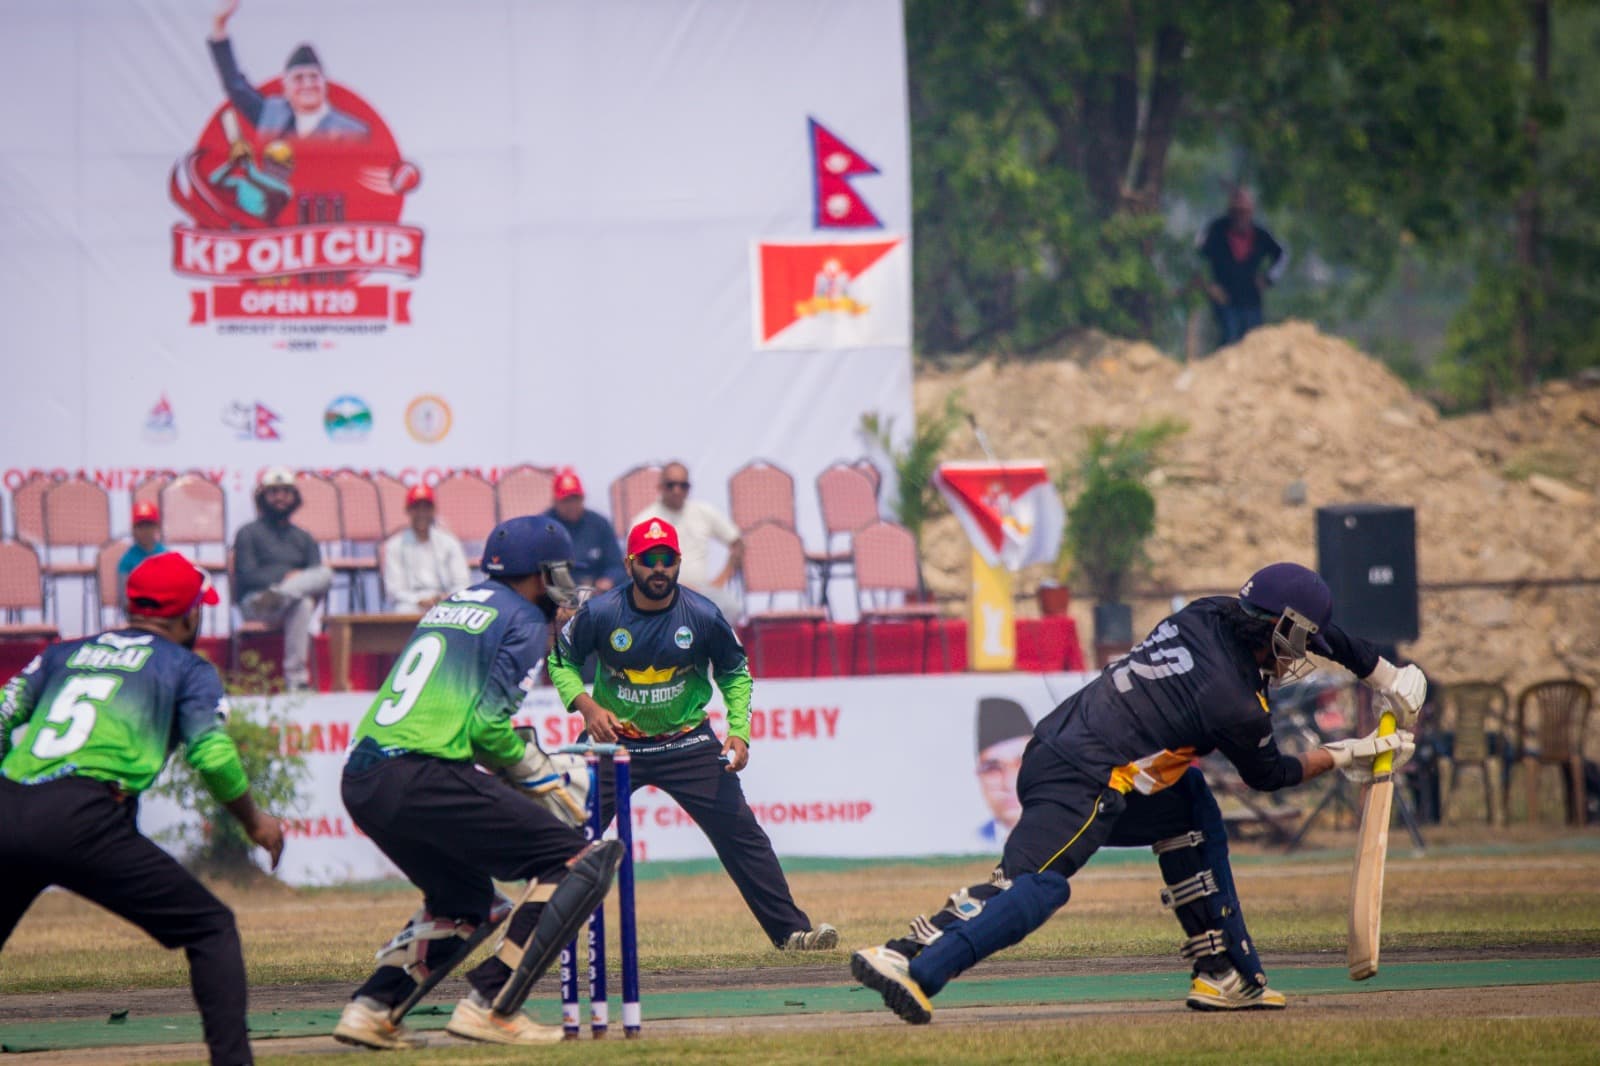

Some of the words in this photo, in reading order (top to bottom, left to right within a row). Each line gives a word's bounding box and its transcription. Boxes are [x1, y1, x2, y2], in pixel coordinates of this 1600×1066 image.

[181, 235, 241, 273] KP
[247, 233, 314, 272] OLI
[322, 229, 412, 265] CUP
[240, 289, 308, 314] OPEN
[312, 289, 358, 314] T20
[376, 632, 442, 725] 9
[616, 685, 649, 705] BOAT
[650, 680, 687, 704] HOUSE
[32, 676, 118, 759] 5
[707, 706, 841, 740] CDEMY
[654, 801, 873, 827] CHIONSHIP
